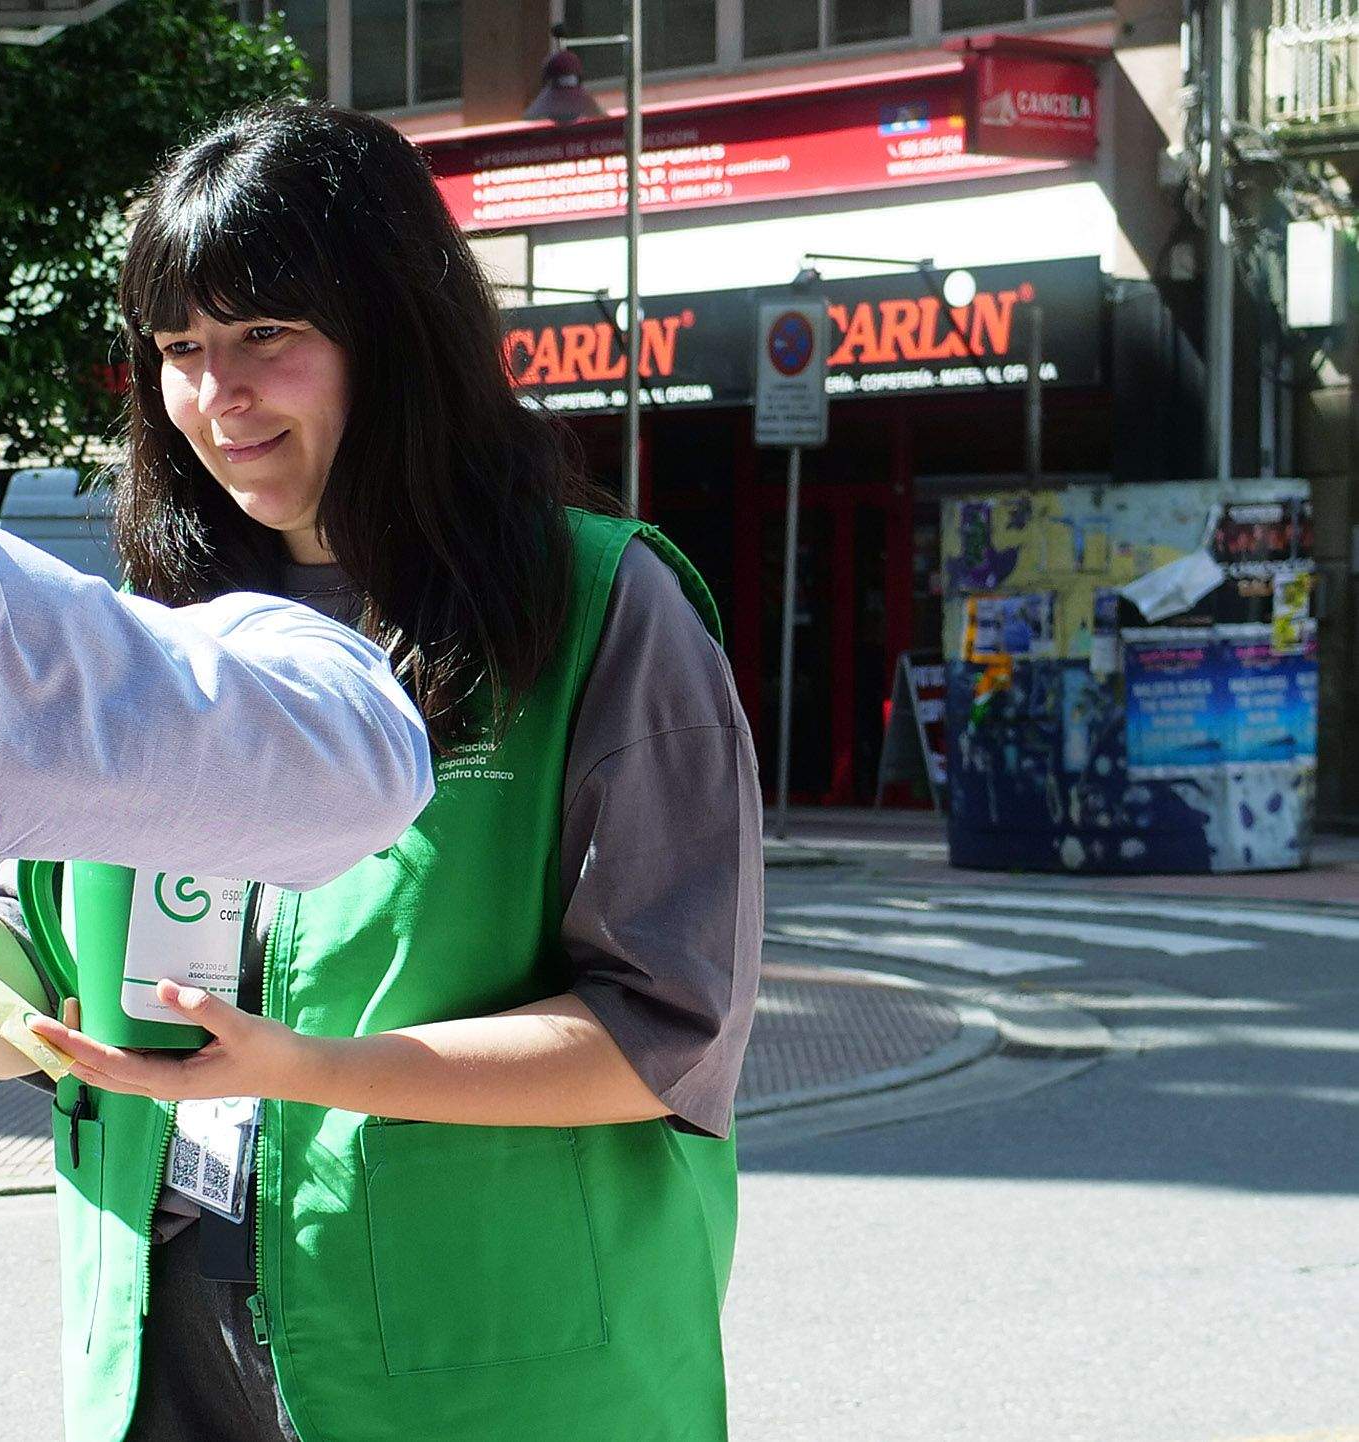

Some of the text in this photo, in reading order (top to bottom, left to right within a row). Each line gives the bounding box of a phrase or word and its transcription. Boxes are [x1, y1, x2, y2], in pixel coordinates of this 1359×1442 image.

[1016, 90, 1092, 117] CANCELA
[482, 173, 618, 203] AUTORIZACIONES
[482, 191, 618, 221] AUTORIZACIONES
[826, 291, 1017, 366] ARLIN
[503, 316, 680, 387] CARLN
[437, 769, 515, 782] contra o cancro
